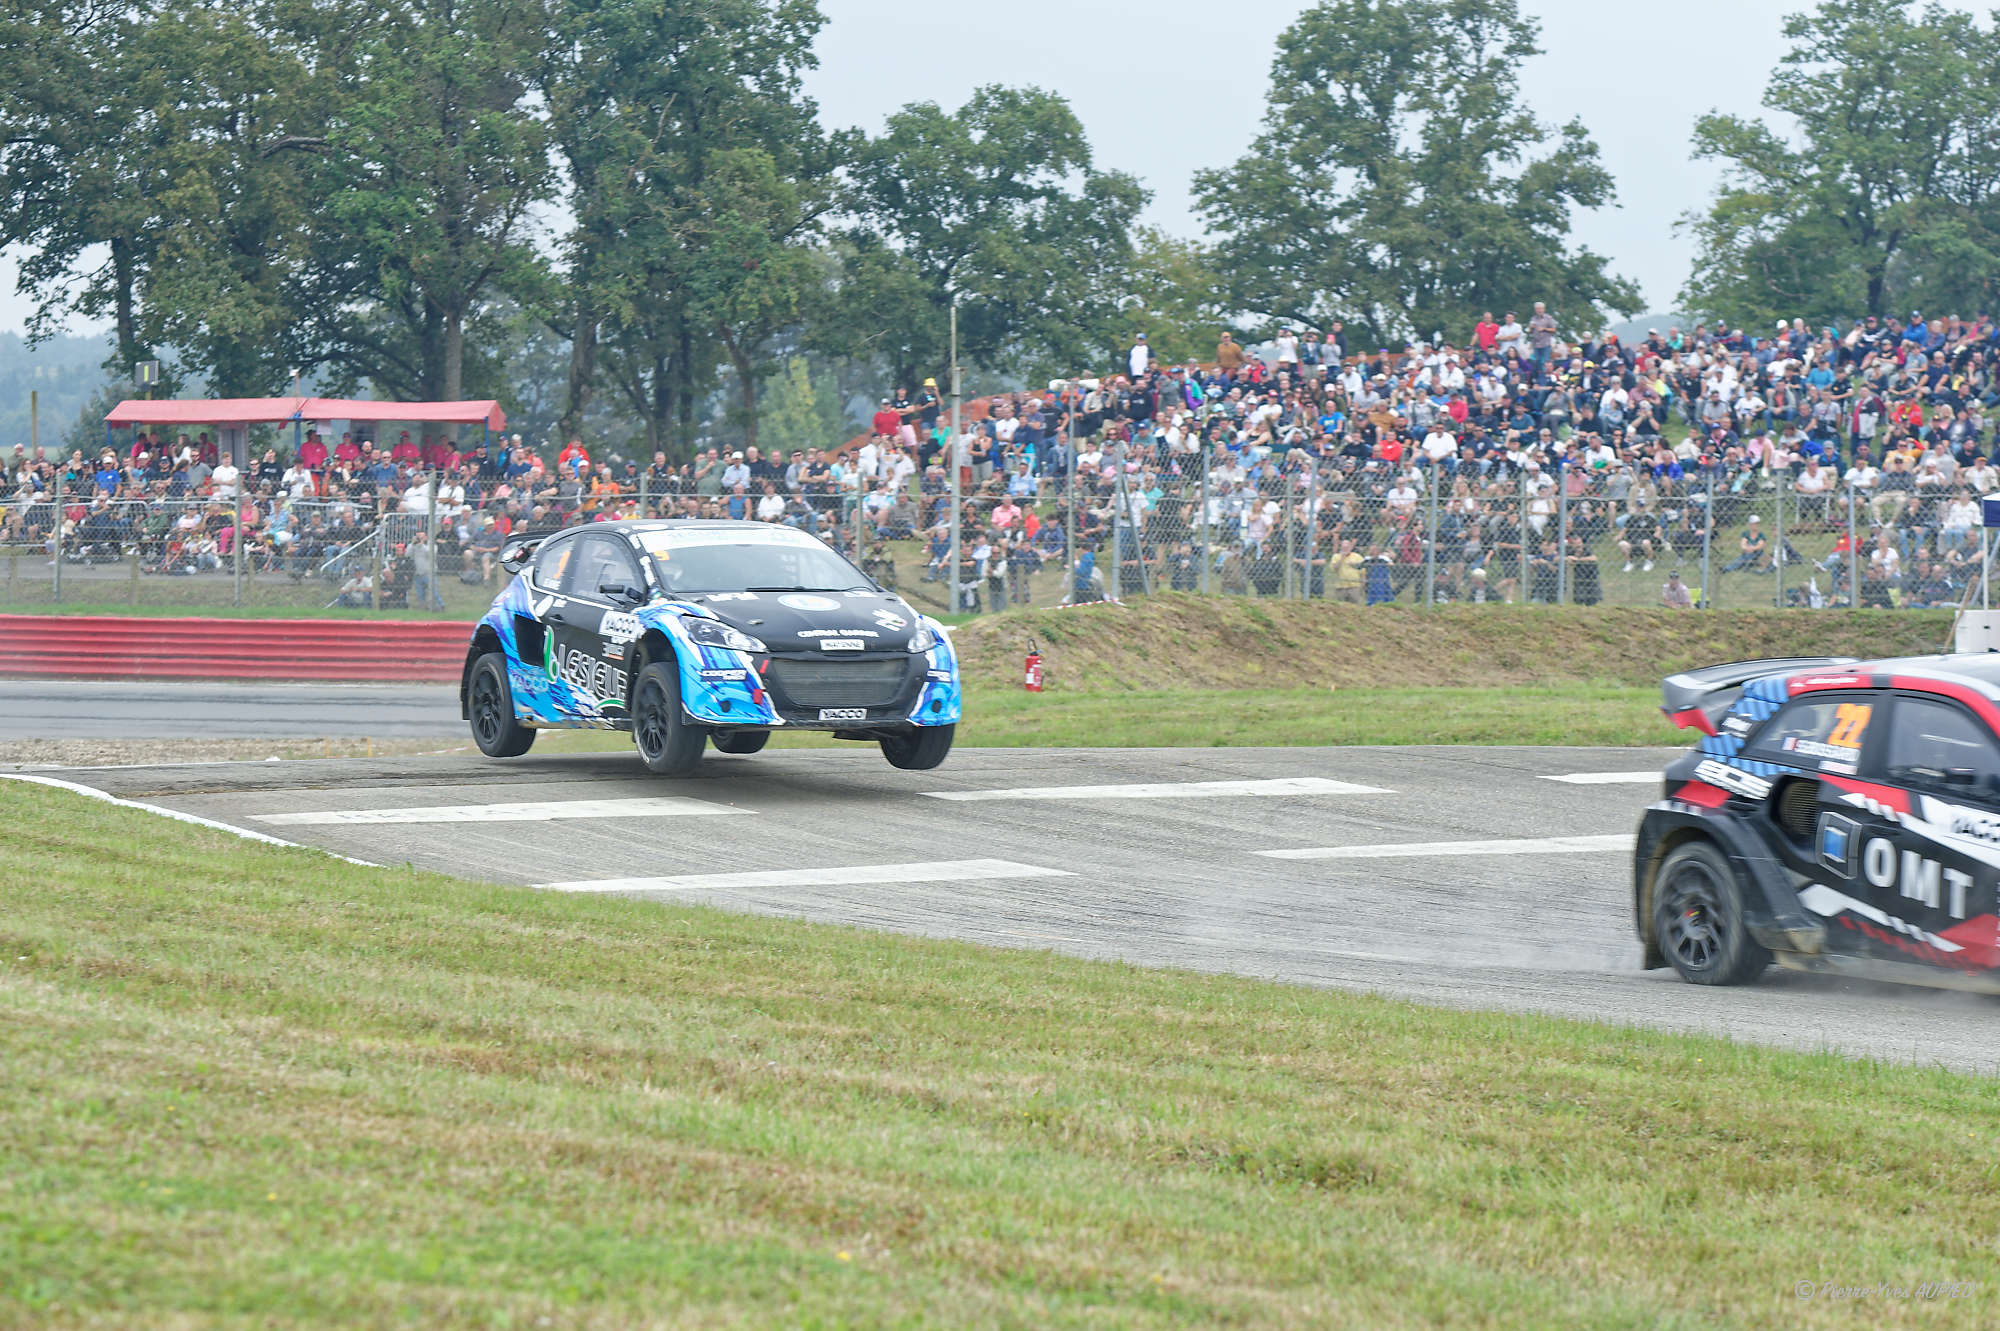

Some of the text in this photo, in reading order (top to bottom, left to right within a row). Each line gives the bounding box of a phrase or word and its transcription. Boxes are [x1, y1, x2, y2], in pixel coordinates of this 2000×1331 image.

[822, 710, 863, 719] YACCO
[1827, 703, 1872, 748] 22
[1864, 837, 1974, 919] OMT
